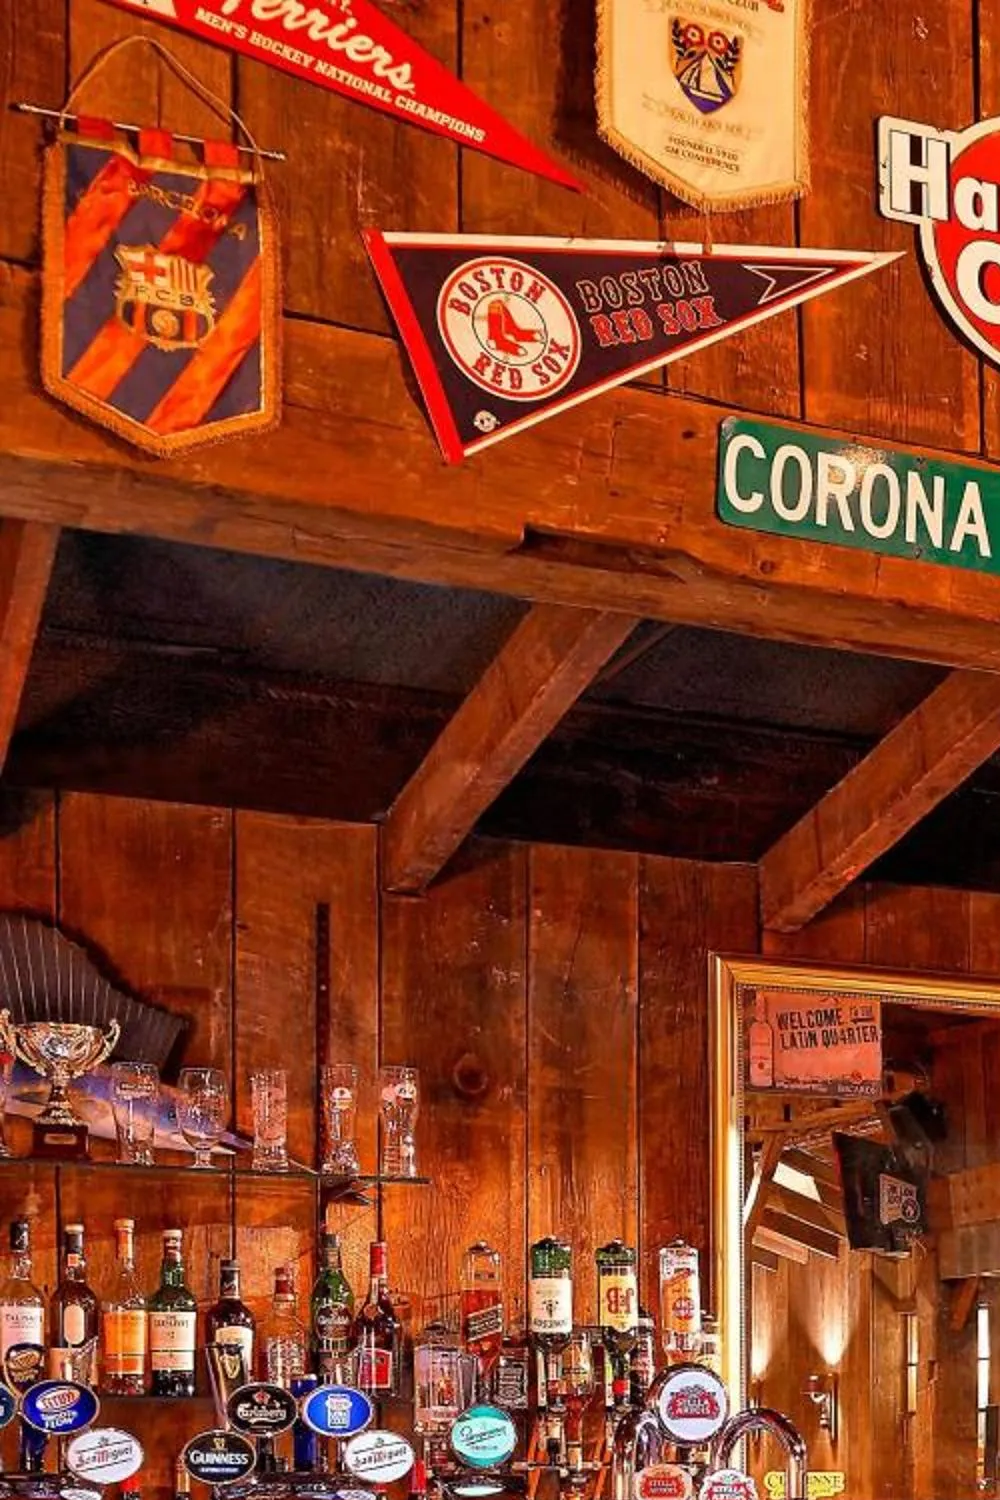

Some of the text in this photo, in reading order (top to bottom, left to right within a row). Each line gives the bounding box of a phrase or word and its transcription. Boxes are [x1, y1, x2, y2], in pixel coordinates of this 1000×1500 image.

[195, 8, 486, 142] MEN'S HOCKEY NATIONAL CHAMPIONS
[576, 261, 710, 313] BOSTON
[448, 266, 571, 389] BOSTON RED SOX
[590, 296, 722, 347] RED SOX
[723, 433, 992, 558] CORONA
[776, 1008, 843, 1030] WELCOME
[780, 1028, 818, 1050] LATIN
[237, 1401, 286, 1423] Carlsberg
[190, 1450, 248, 1465] GUINNESS
